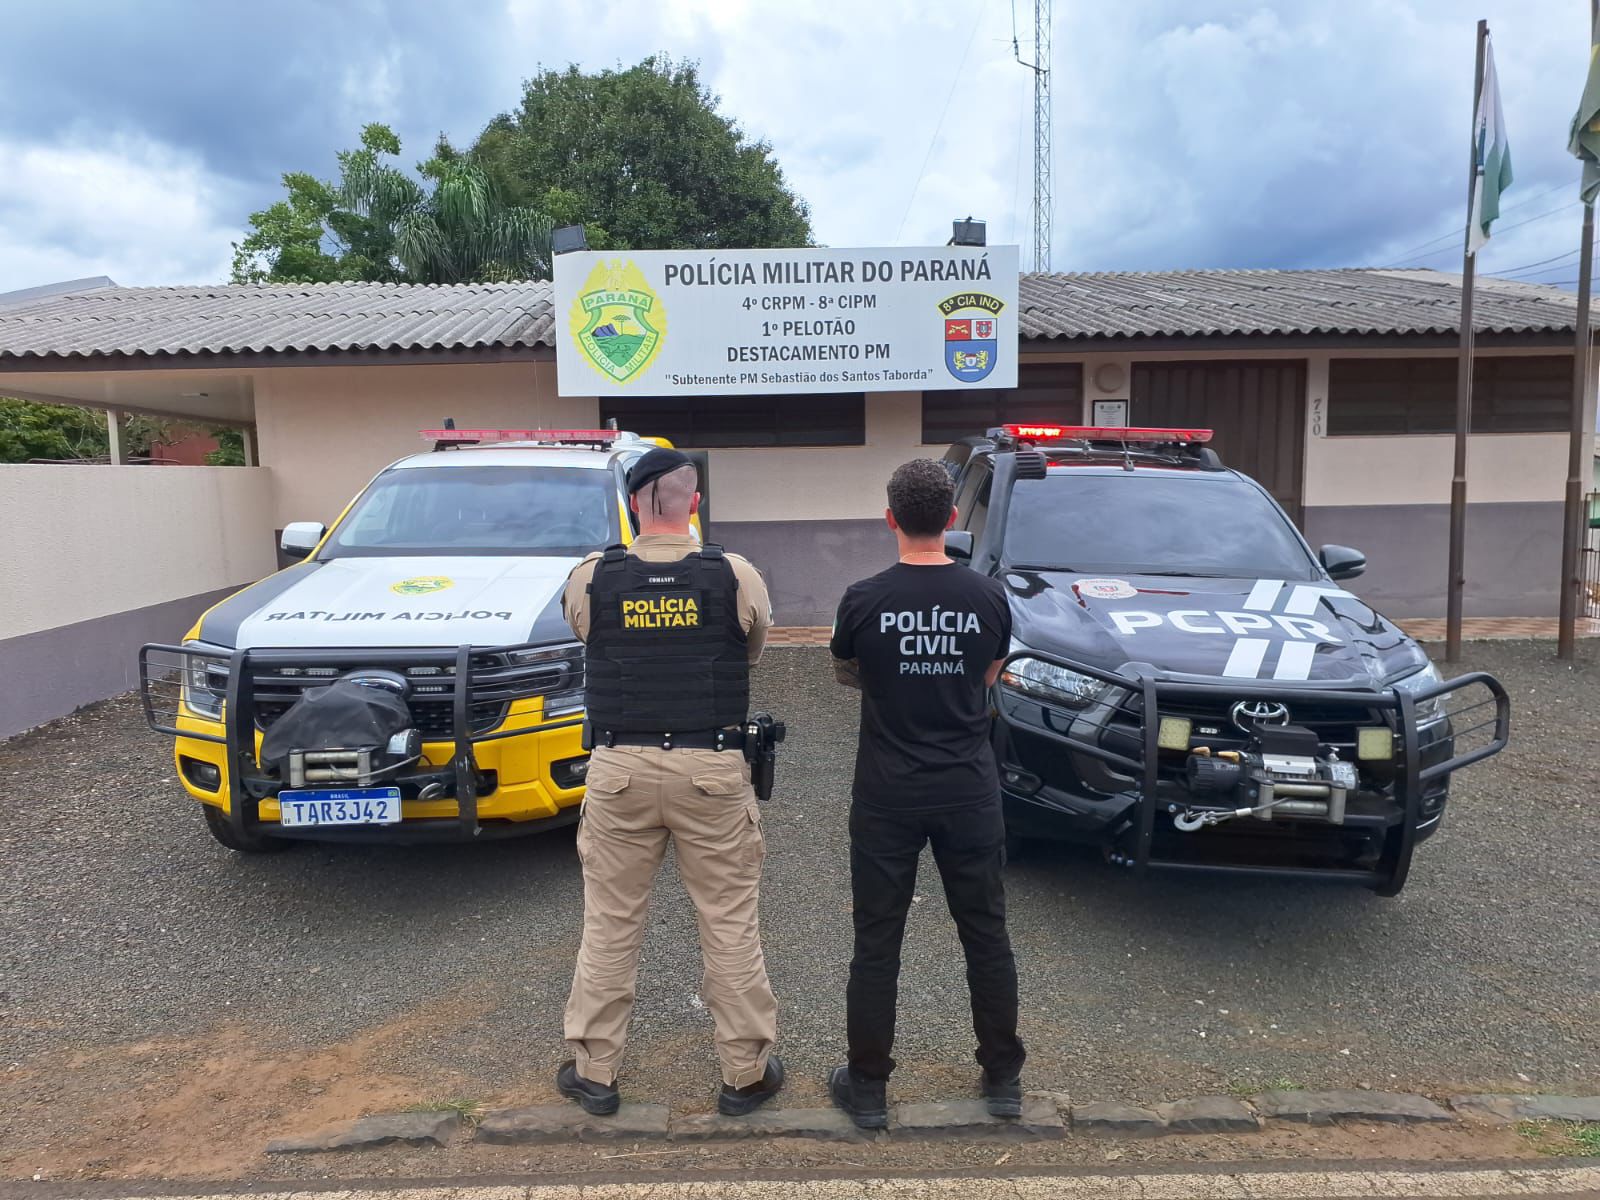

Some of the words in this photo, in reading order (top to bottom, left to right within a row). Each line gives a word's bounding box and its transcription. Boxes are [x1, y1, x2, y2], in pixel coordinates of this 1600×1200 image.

[664, 257, 756, 286] POLÍCIA
[763, 261, 855, 285] MILITAR
[862, 260, 893, 283] DO
[900, 252, 992, 282] PARANÁ
[761, 296, 805, 311] CRPM
[838, 294, 877, 309] CIPM
[957, 295, 976, 306] CIA
[979, 296, 999, 310] IND
[783, 316, 855, 337] PELOTÃO
[624, 335, 654, 373] MILITAR
[727, 344, 859, 362] DESTACAMENTO
[864, 343, 890, 360] PM
[665, 373, 737, 386] "Subtenente
[740, 372, 758, 385] PM
[761, 371, 817, 384] Sebastião
[819, 372, 839, 383] dos
[842, 370, 880, 382] Santos
[882, 368, 933, 381] Taborda"
[622, 596, 699, 614] POLÍCIA
[624, 612, 699, 629] MILITAR
[880, 605, 981, 634] POLÍCIA
[1107, 609, 1343, 643] PCPR
[900, 635, 963, 656] CIVIL
[899, 659, 965, 675] PARANÁ
[293, 800, 389, 824] TAR3J42
